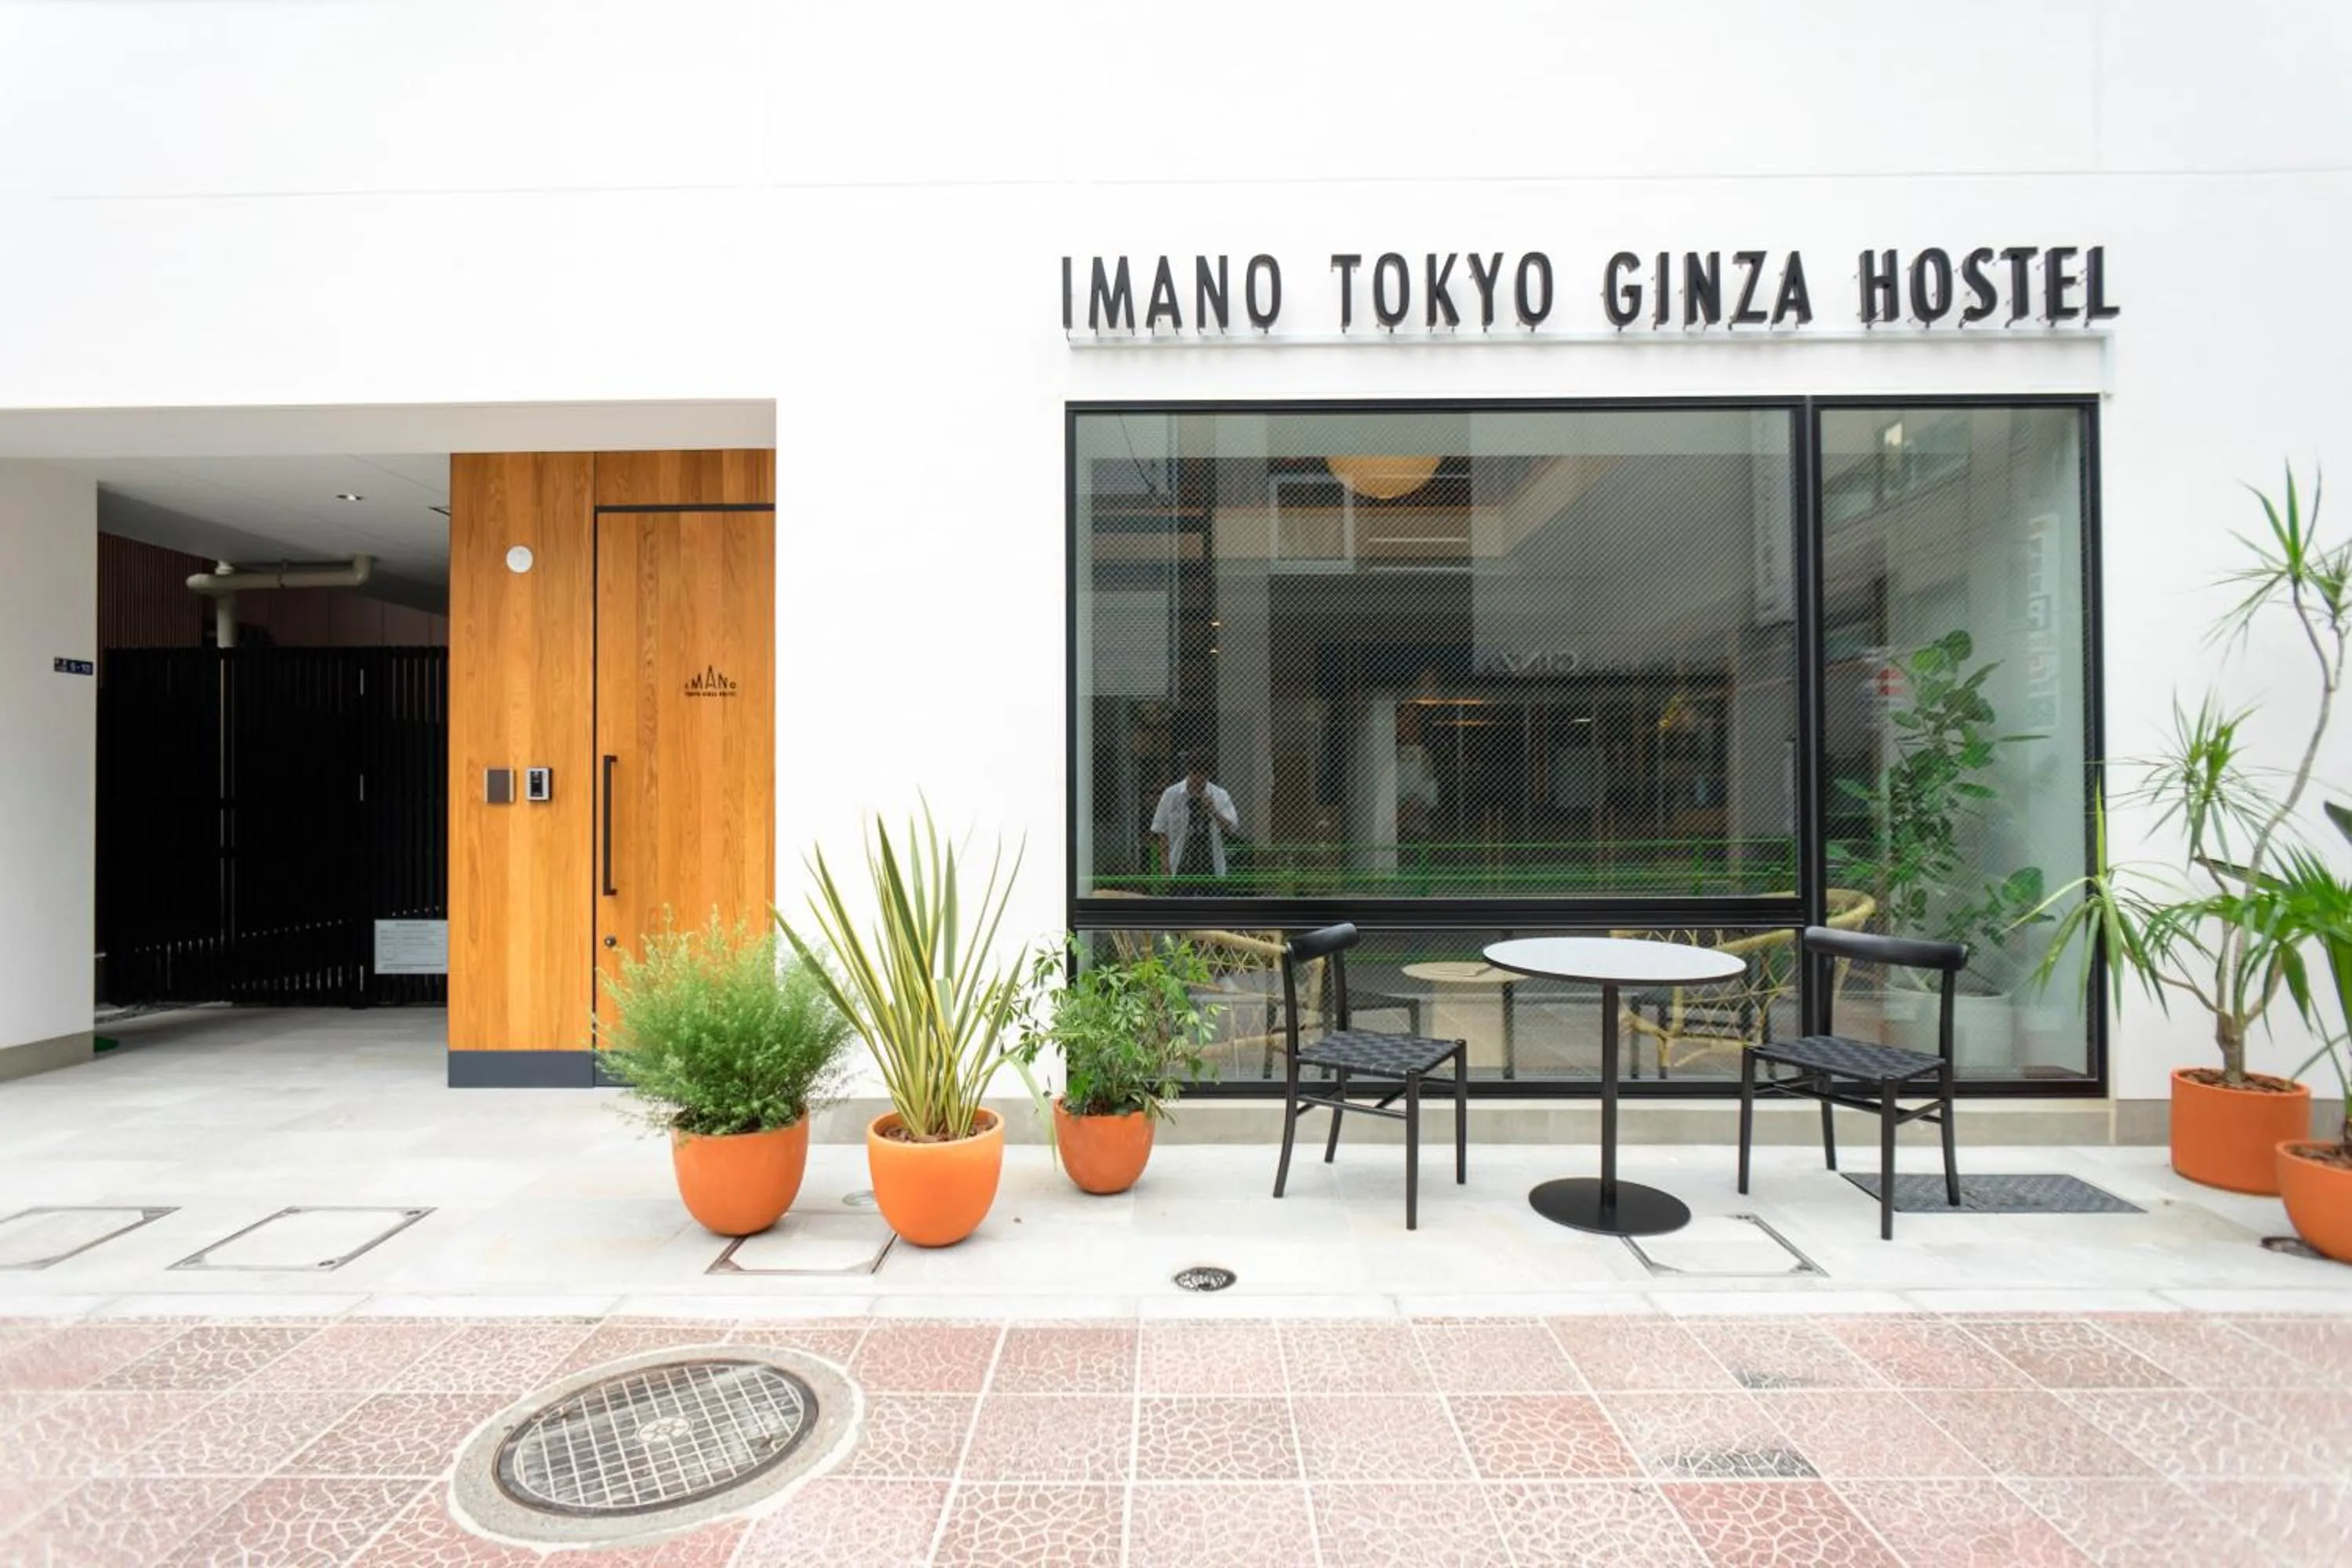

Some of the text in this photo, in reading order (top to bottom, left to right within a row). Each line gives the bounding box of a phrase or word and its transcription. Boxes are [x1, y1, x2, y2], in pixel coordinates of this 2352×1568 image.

[1062, 245, 2121, 330] IMANO TOKYO GINZA HOSTEL
